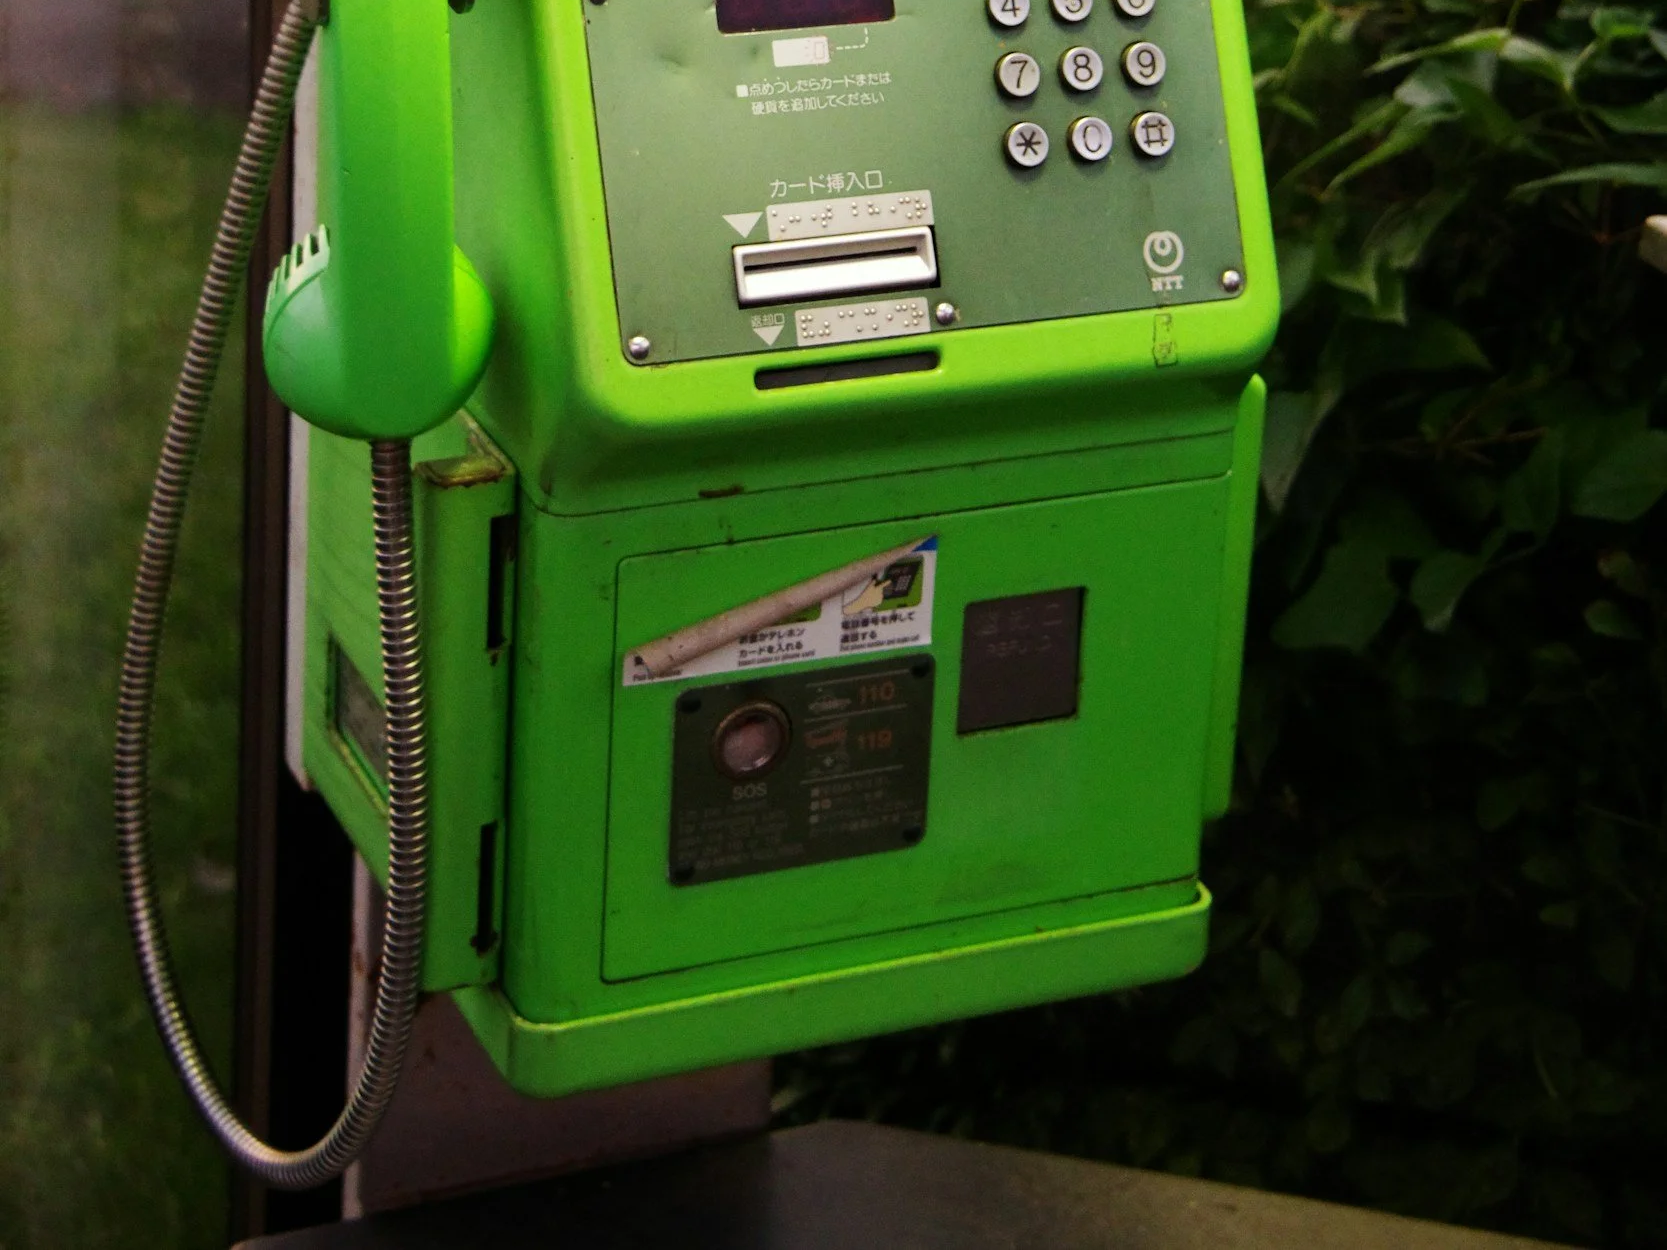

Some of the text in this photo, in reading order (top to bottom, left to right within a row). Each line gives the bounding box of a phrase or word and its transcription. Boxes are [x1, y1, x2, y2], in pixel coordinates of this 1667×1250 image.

[751, 92, 885, 116] 硬貨を追加してください
[769, 170, 884, 198] カード挿入口
[1151, 275, 1184, 292] NTT
[732, 782, 768, 800] SOS
